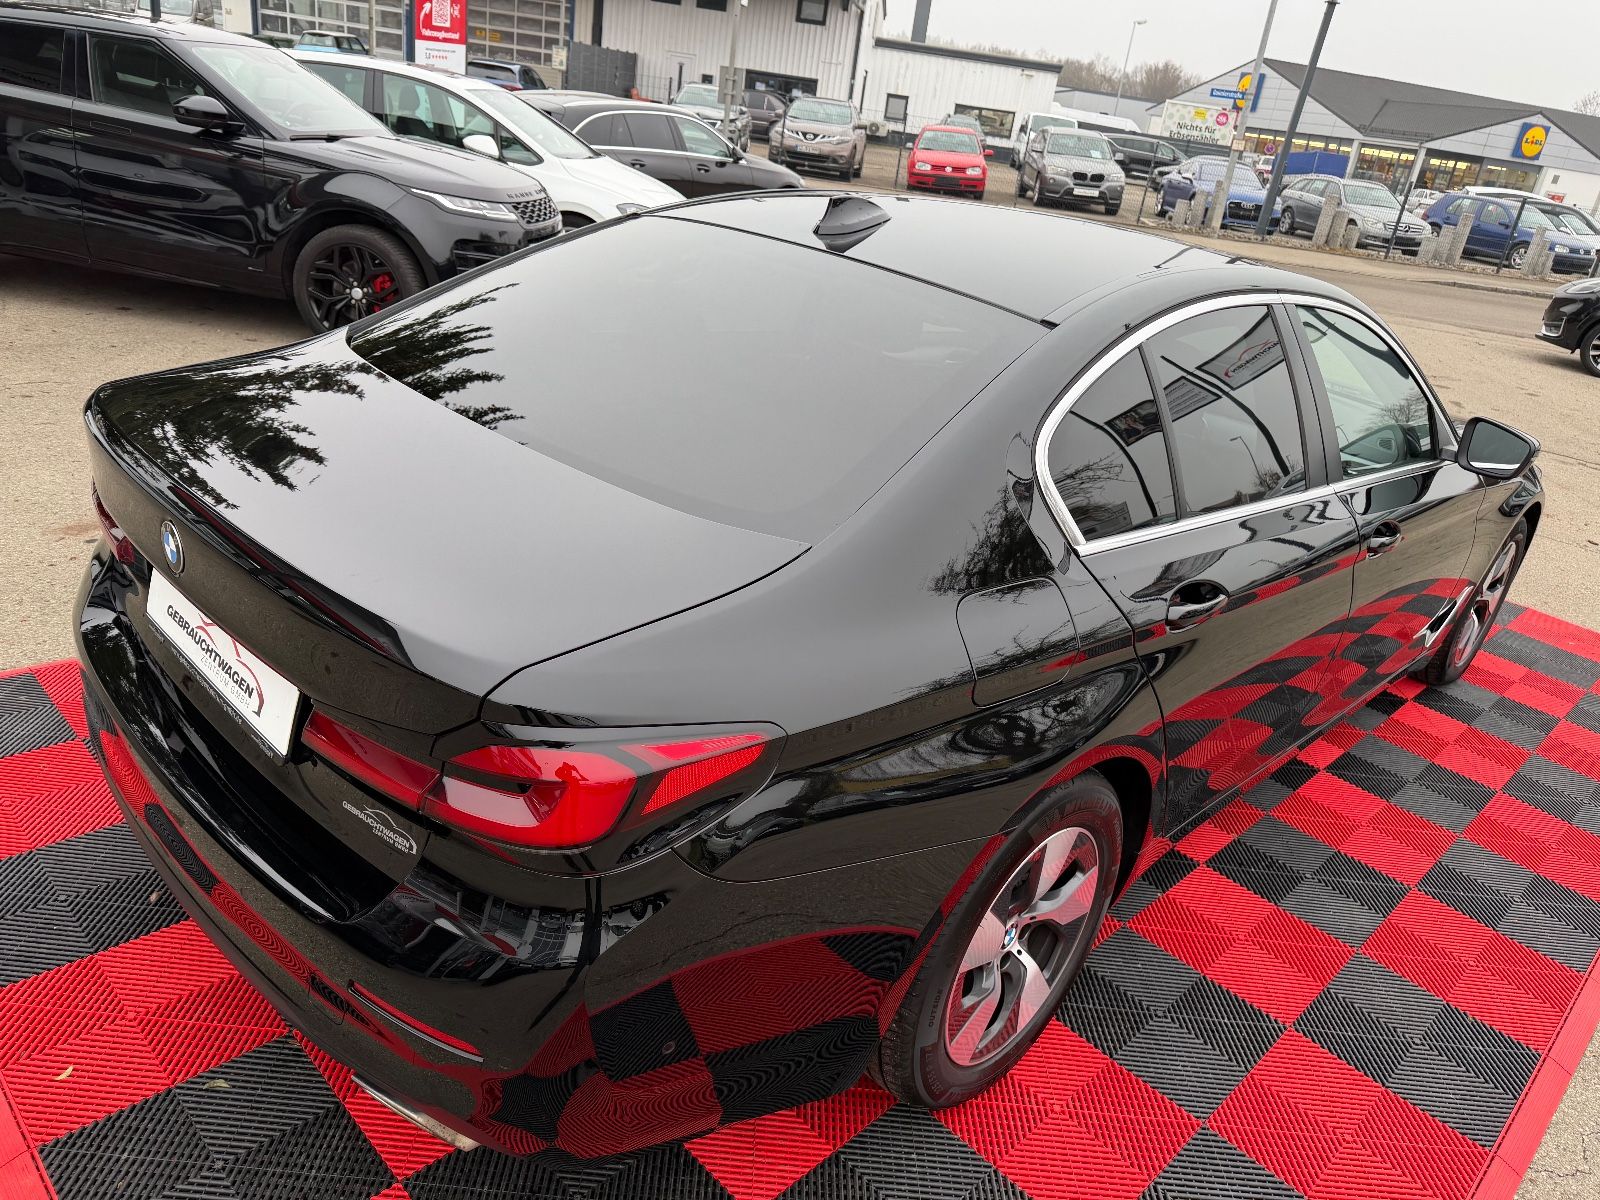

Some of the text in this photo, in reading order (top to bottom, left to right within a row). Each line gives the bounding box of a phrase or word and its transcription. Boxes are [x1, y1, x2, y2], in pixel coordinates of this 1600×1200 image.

[1176, 121, 1217, 134] Nichts für
[166, 604, 254, 699] GEBRAUCHTWAGEN
[200, 654, 231, 689] ZENTRUM
[342, 800, 410, 848] GEBRAUCHTWAGEN
